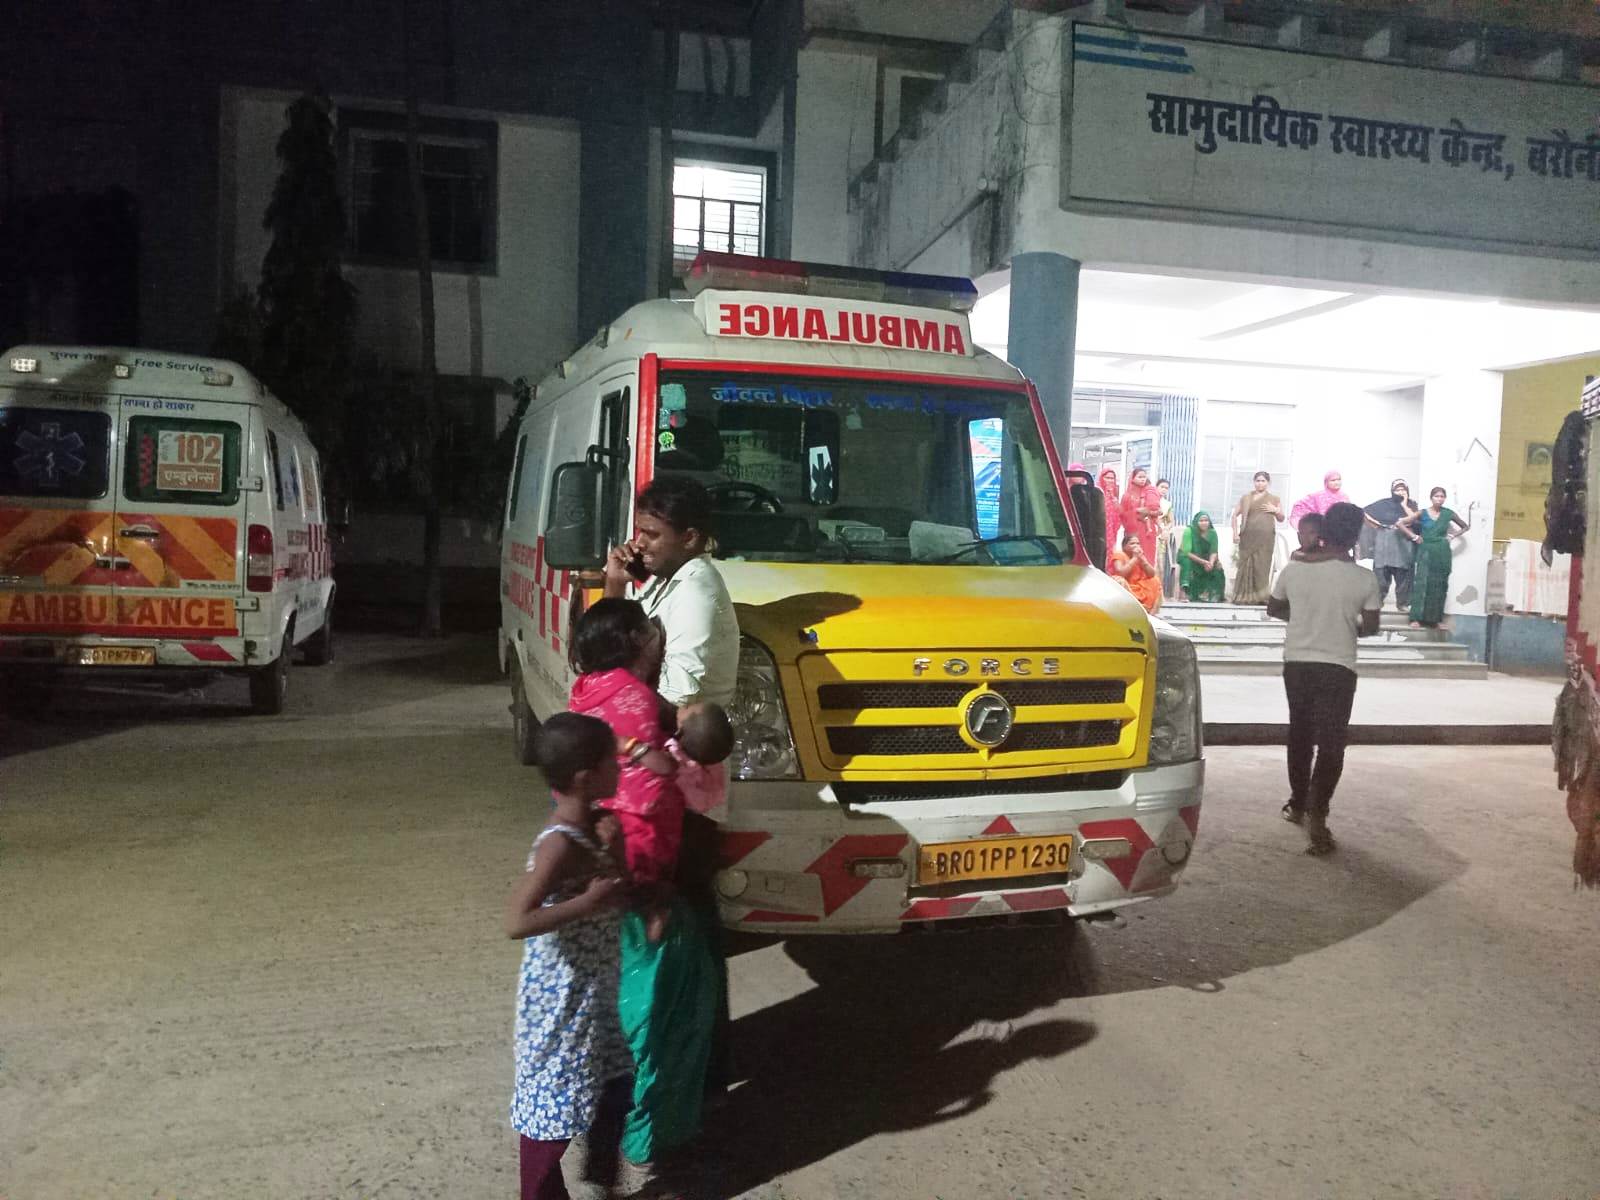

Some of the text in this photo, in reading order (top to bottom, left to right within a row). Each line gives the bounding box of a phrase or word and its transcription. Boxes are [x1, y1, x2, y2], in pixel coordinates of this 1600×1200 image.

[1146, 93, 1323, 154] सामुदायिक
[1328, 114, 1435, 164] स्वास्थ्य
[134, 358, 214, 373] Free Service
[175, 433, 221, 464] 102
[8, 594, 226, 626] AMBULANCE
[913, 658, 1060, 676] FORCE
[937, 842, 1070, 876] BR01PP1230
